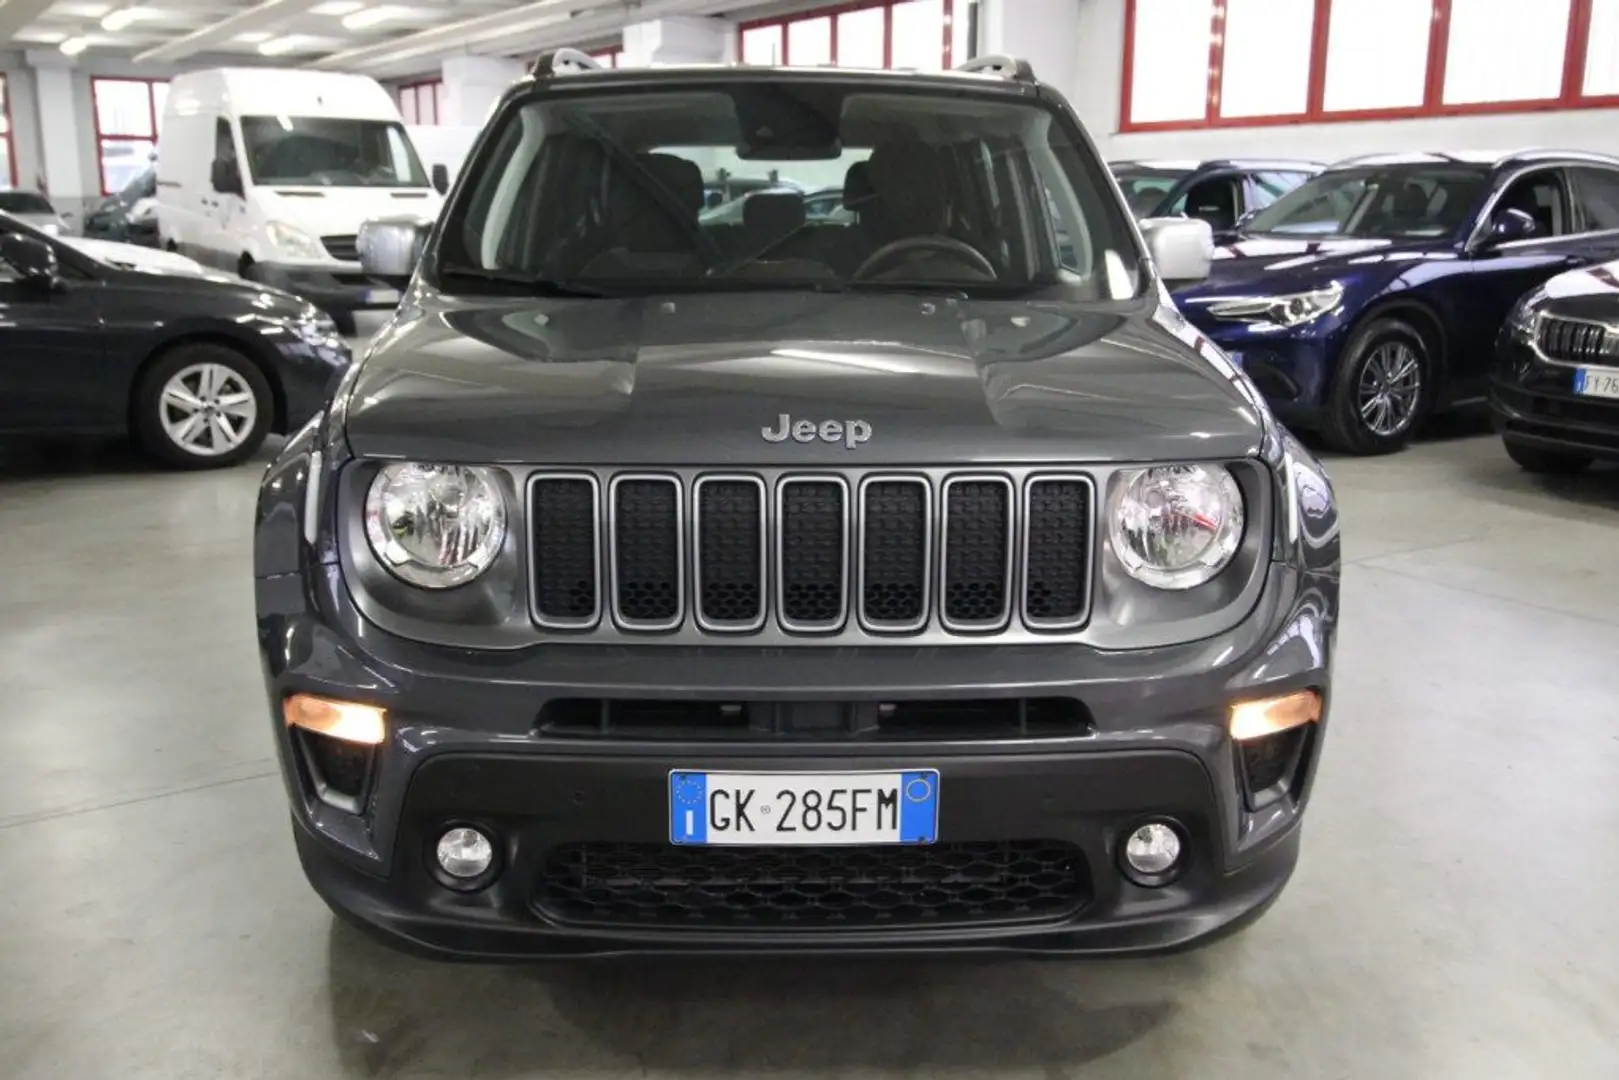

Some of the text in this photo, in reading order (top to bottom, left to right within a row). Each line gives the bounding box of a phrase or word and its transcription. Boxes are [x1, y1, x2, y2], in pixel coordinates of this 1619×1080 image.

[761, 413, 873, 450] Jeep
[709, 788, 898, 832] GK 285FM
